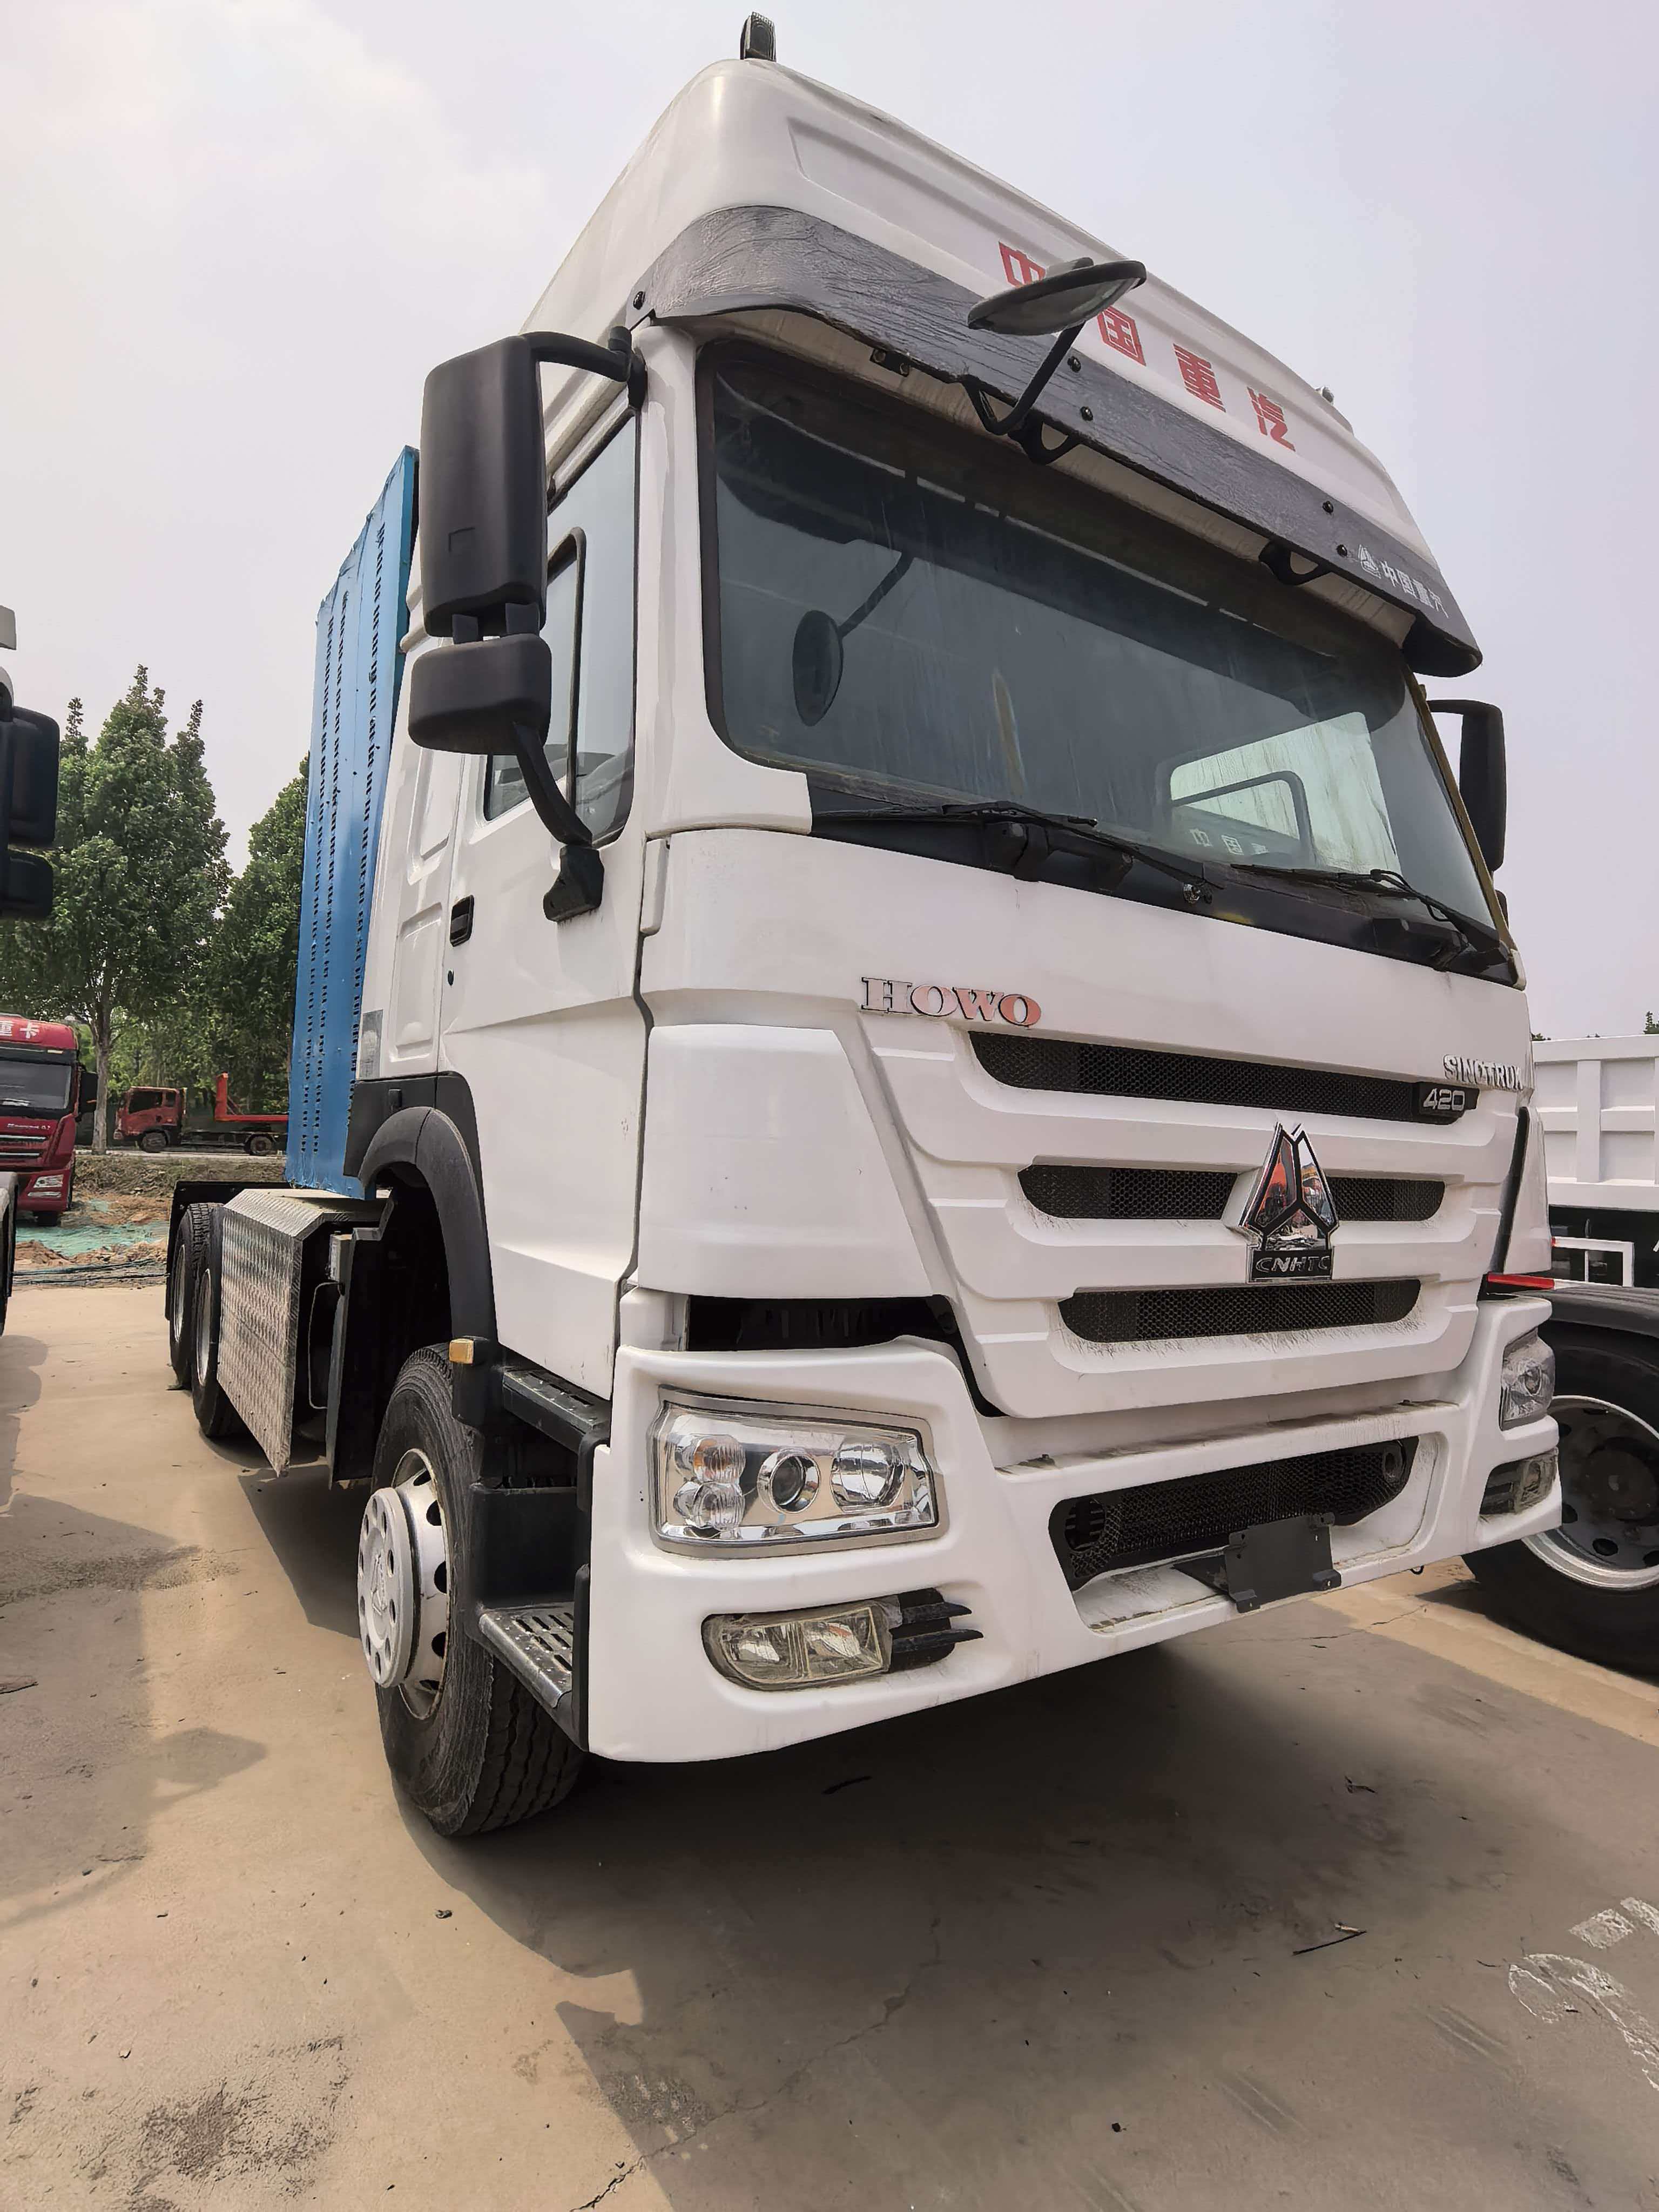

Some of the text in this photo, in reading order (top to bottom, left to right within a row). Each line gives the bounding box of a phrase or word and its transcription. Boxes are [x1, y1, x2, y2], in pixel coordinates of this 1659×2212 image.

[861, 976, 1042, 1028] HOWO
[1443, 1054, 1523, 1090] SINOTRUK
[1423, 1088, 1465, 1111] 420
[1255, 1256, 1330, 1272] CNHTC
